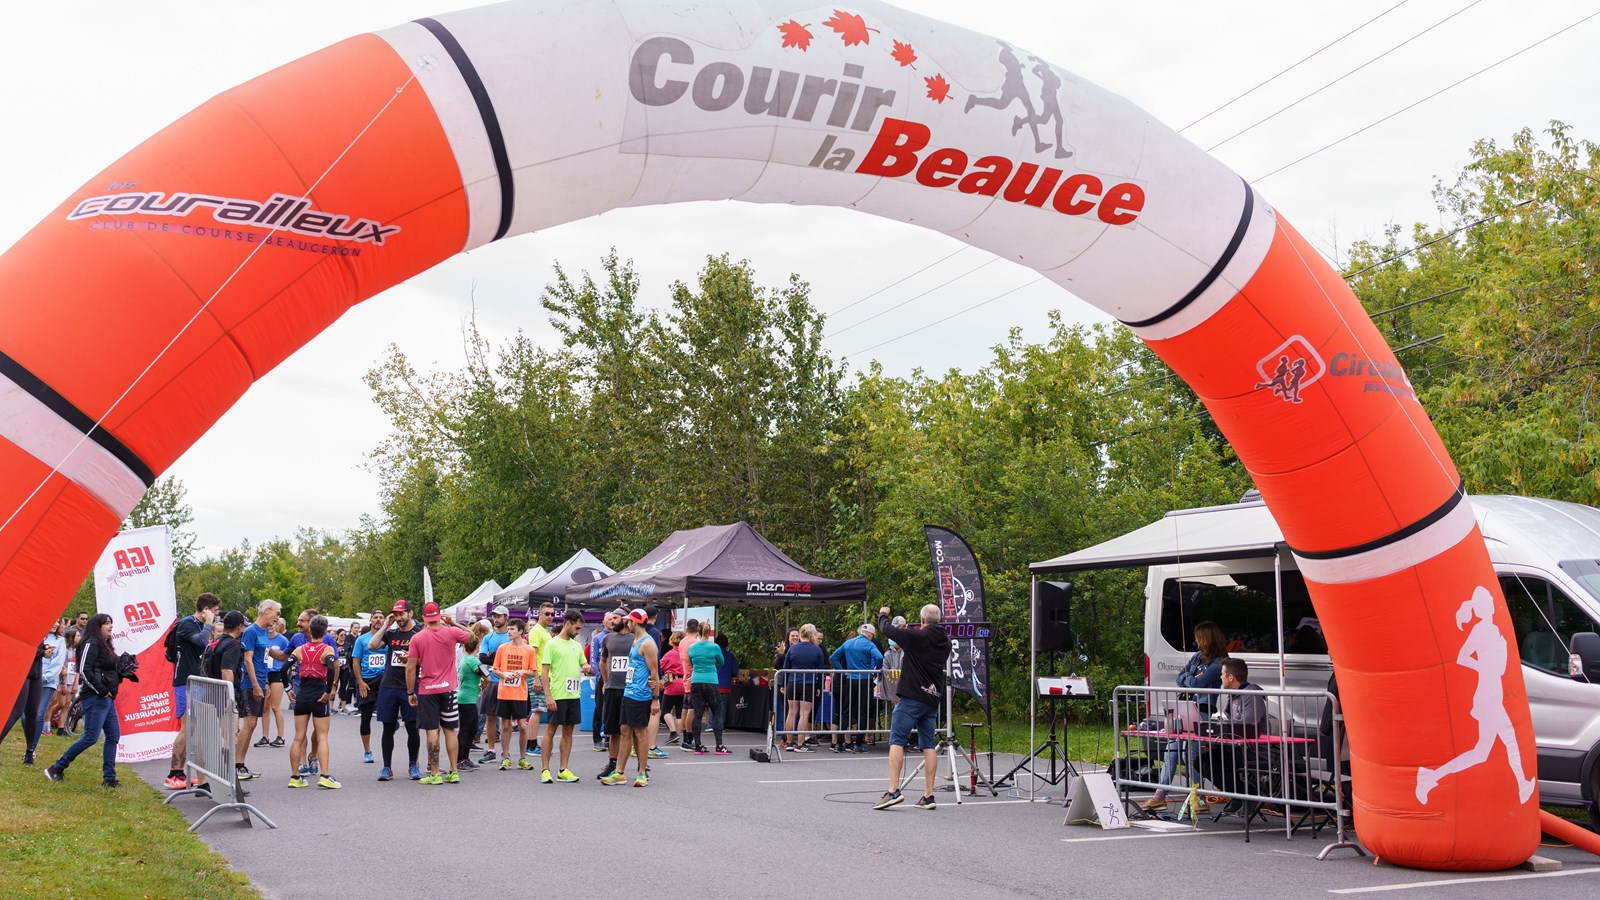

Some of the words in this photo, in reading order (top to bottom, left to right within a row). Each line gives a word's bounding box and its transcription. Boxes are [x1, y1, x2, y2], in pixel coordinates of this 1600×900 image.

[628, 36, 896, 132] Courir
[809, 134, 856, 172] la
[854, 117, 1146, 226] Beauce
[68, 192, 401, 246] courailleux
[90, 221, 135, 230] CLUB
[147, 223, 169, 231] DE
[182, 225, 254, 243] COURSE
[266, 235, 362, 257] BEAUCERON
[746, 582, 811, 592] intencité
[369, 655, 385, 666] 205
[612, 658, 628, 669] 217
[567, 679, 579, 691] 211
